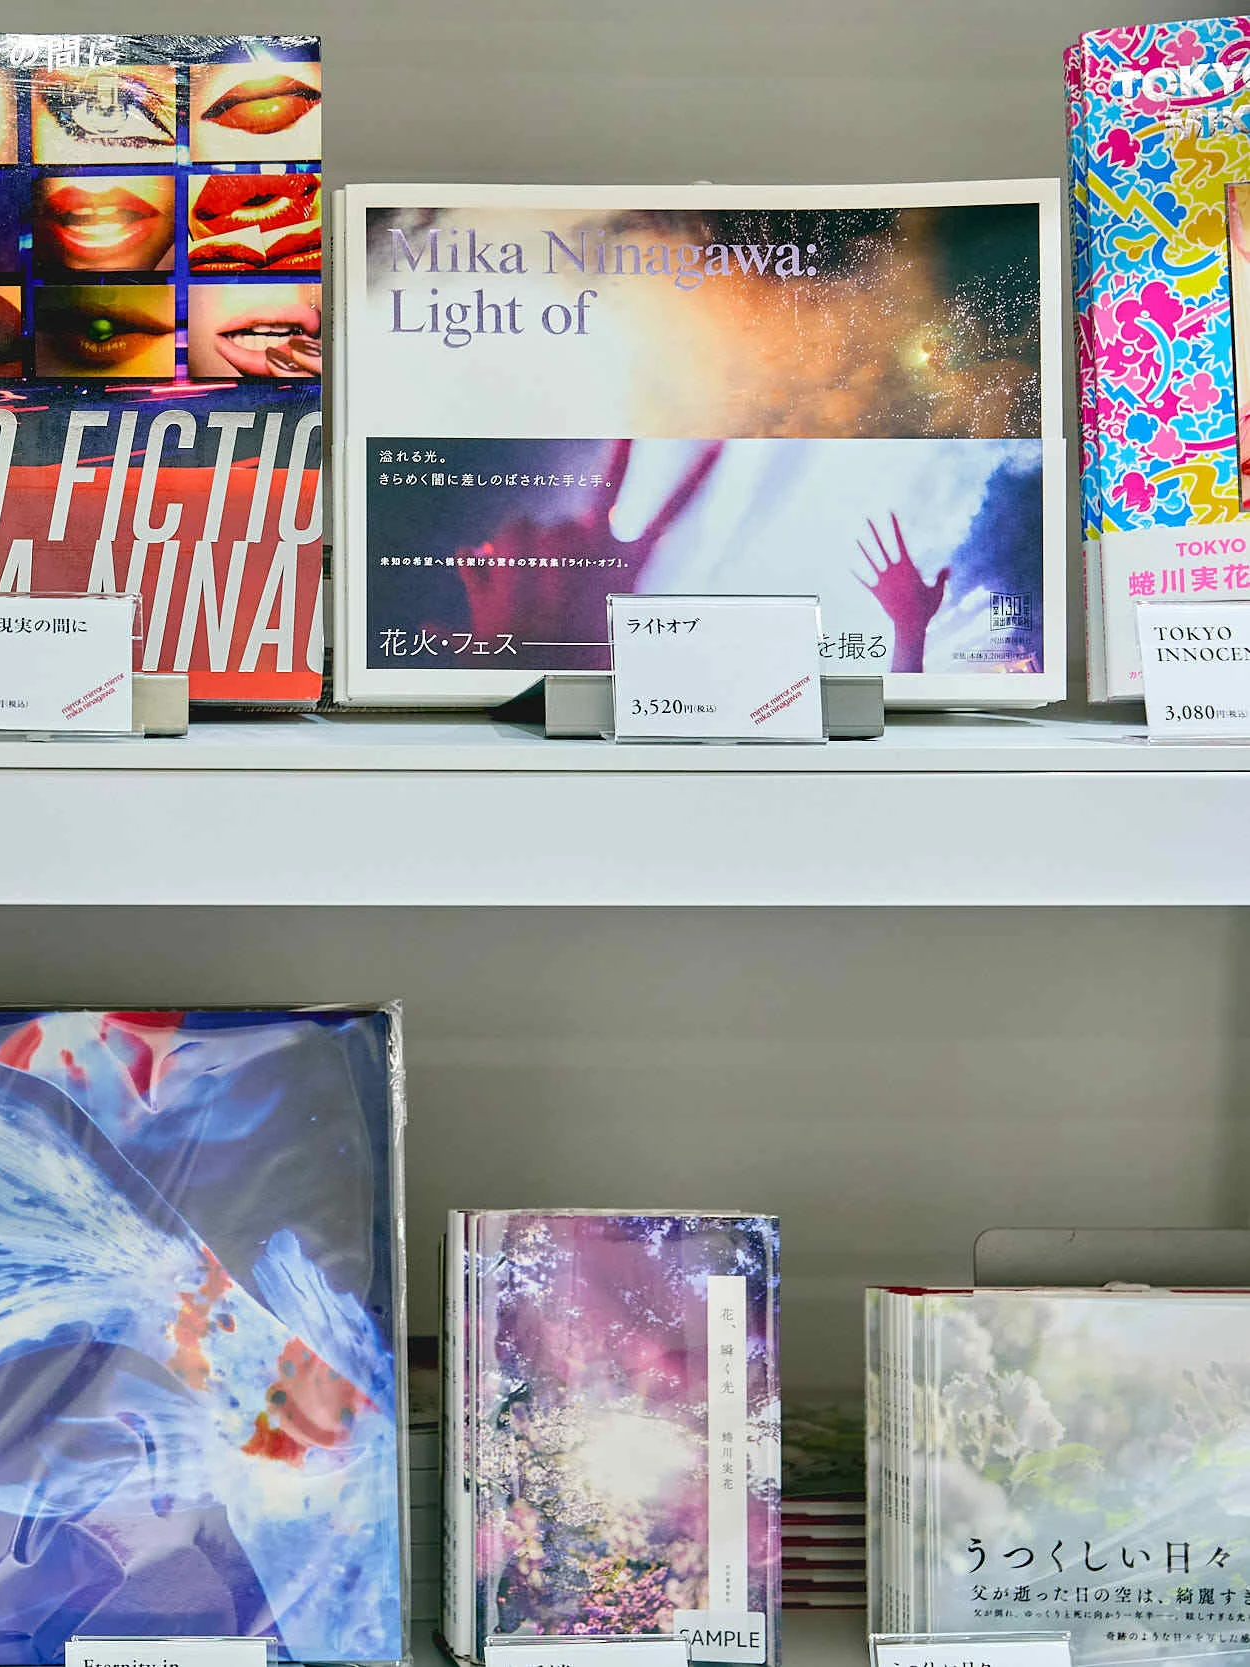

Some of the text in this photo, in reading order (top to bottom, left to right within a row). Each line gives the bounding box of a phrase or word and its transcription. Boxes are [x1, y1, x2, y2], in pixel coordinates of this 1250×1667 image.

[387, 228, 818, 291] Mika Ninagawa:
[390, 288, 526, 348] Light
[541, 289, 599, 336] of
[378, 450, 447, 464] 溢れる光。
[378, 473, 613, 488] きらめく闇に差しのばされた手と手。
[1176, 538, 1247, 558] TOKYO
[1128, 563, 1250, 598] 蜷川実花
[626, 617, 702, 635] ライトオブ
[1153, 626, 1233, 642] TOKYO
[966, 1537, 1232, 1576] うつくしい日々
